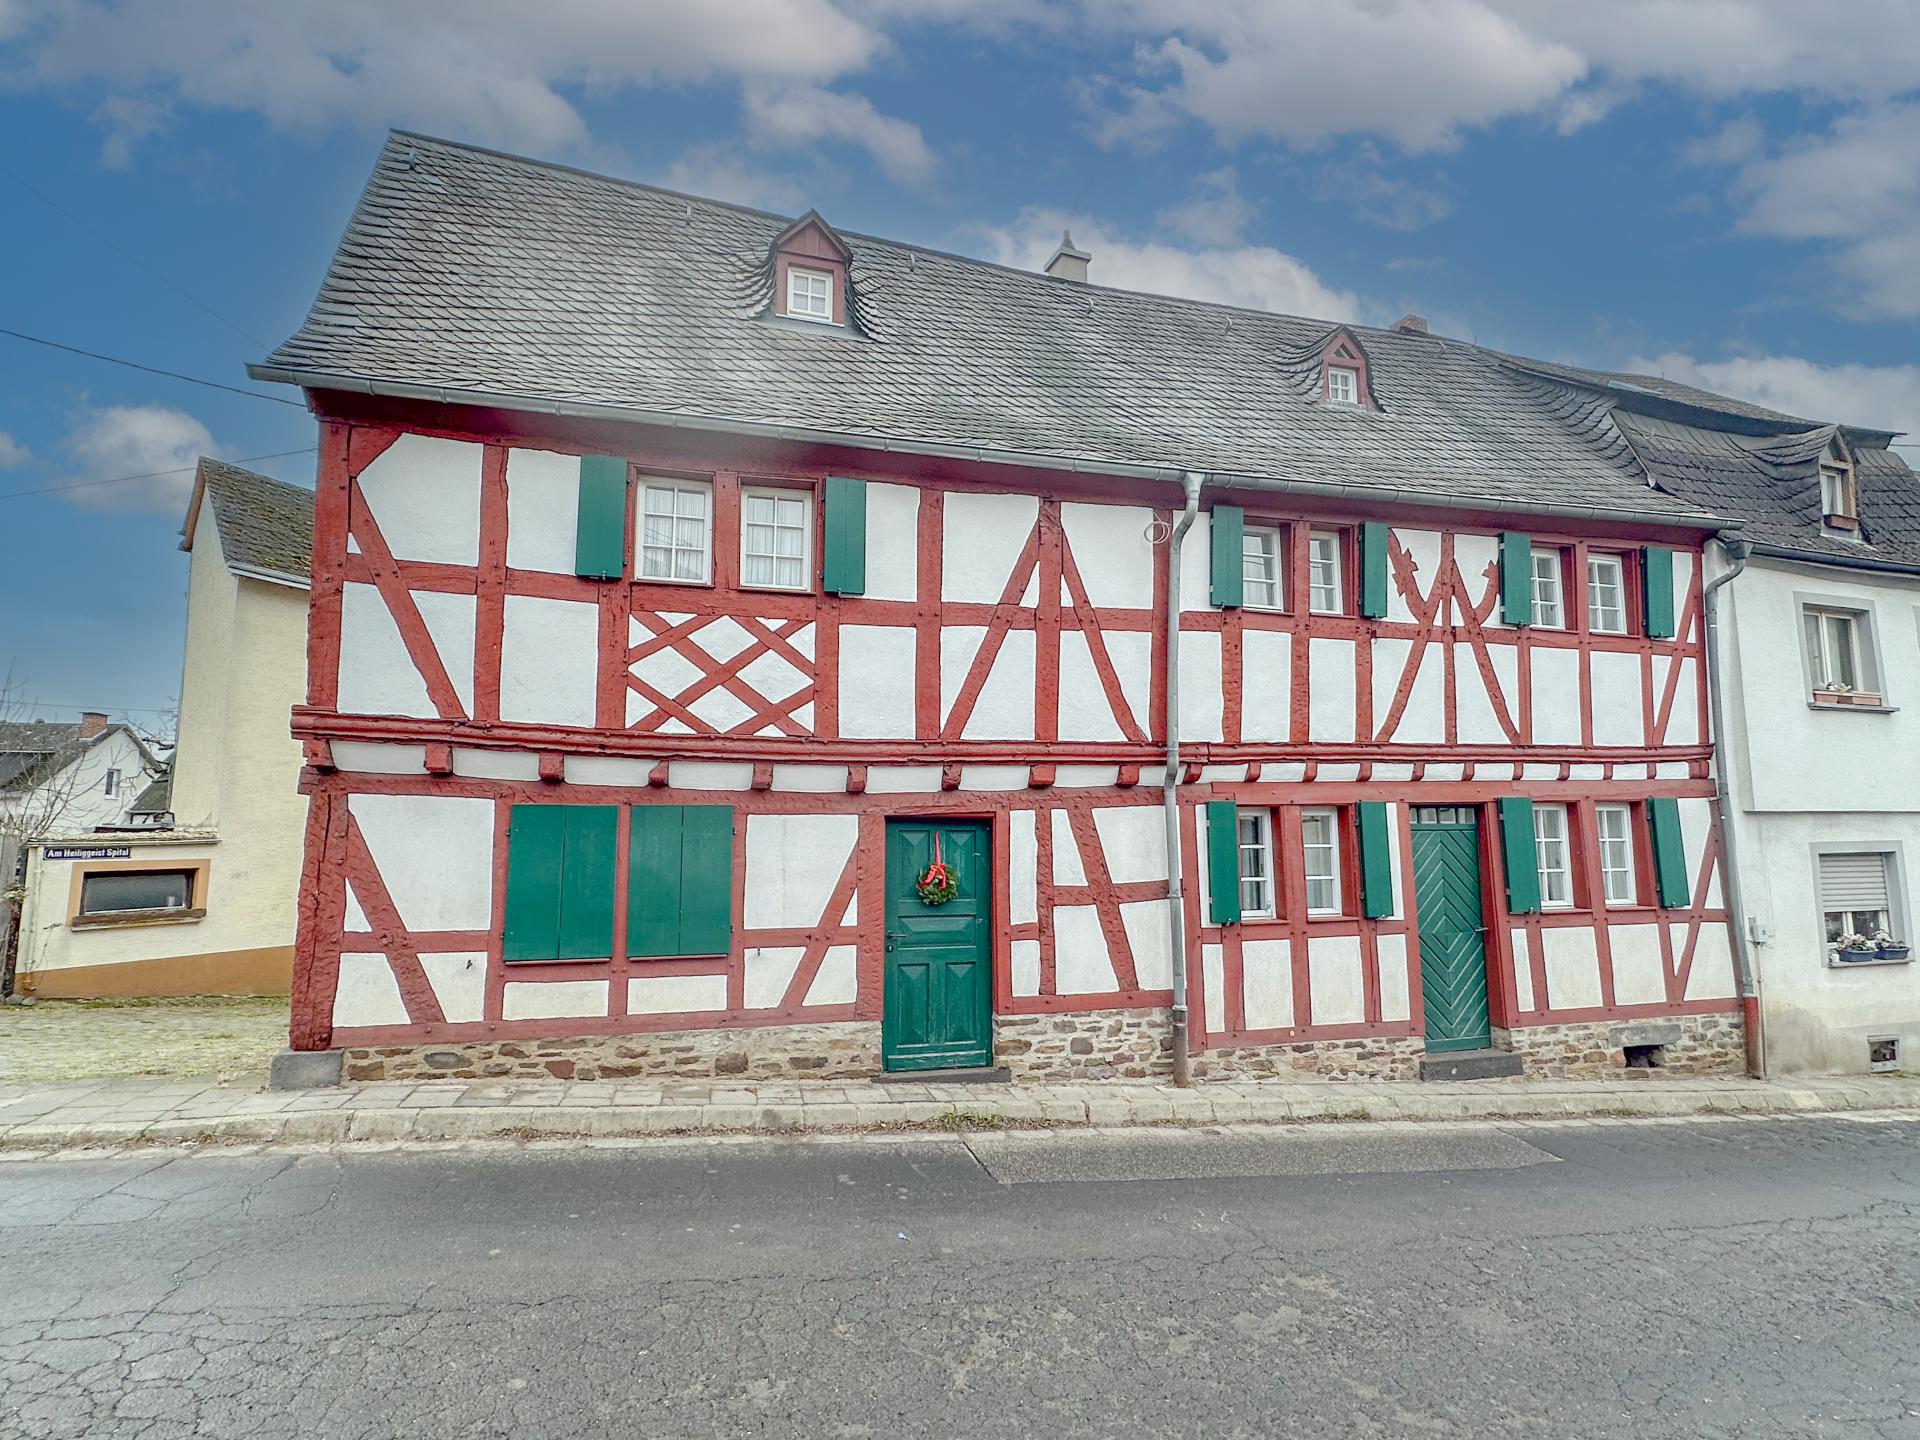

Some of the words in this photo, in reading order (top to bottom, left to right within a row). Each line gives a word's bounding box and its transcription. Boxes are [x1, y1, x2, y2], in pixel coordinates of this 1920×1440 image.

[47, 849, 62, 857] Am
[63, 848, 105, 858] Heiliggeist
[106, 848, 129, 857] Spital
